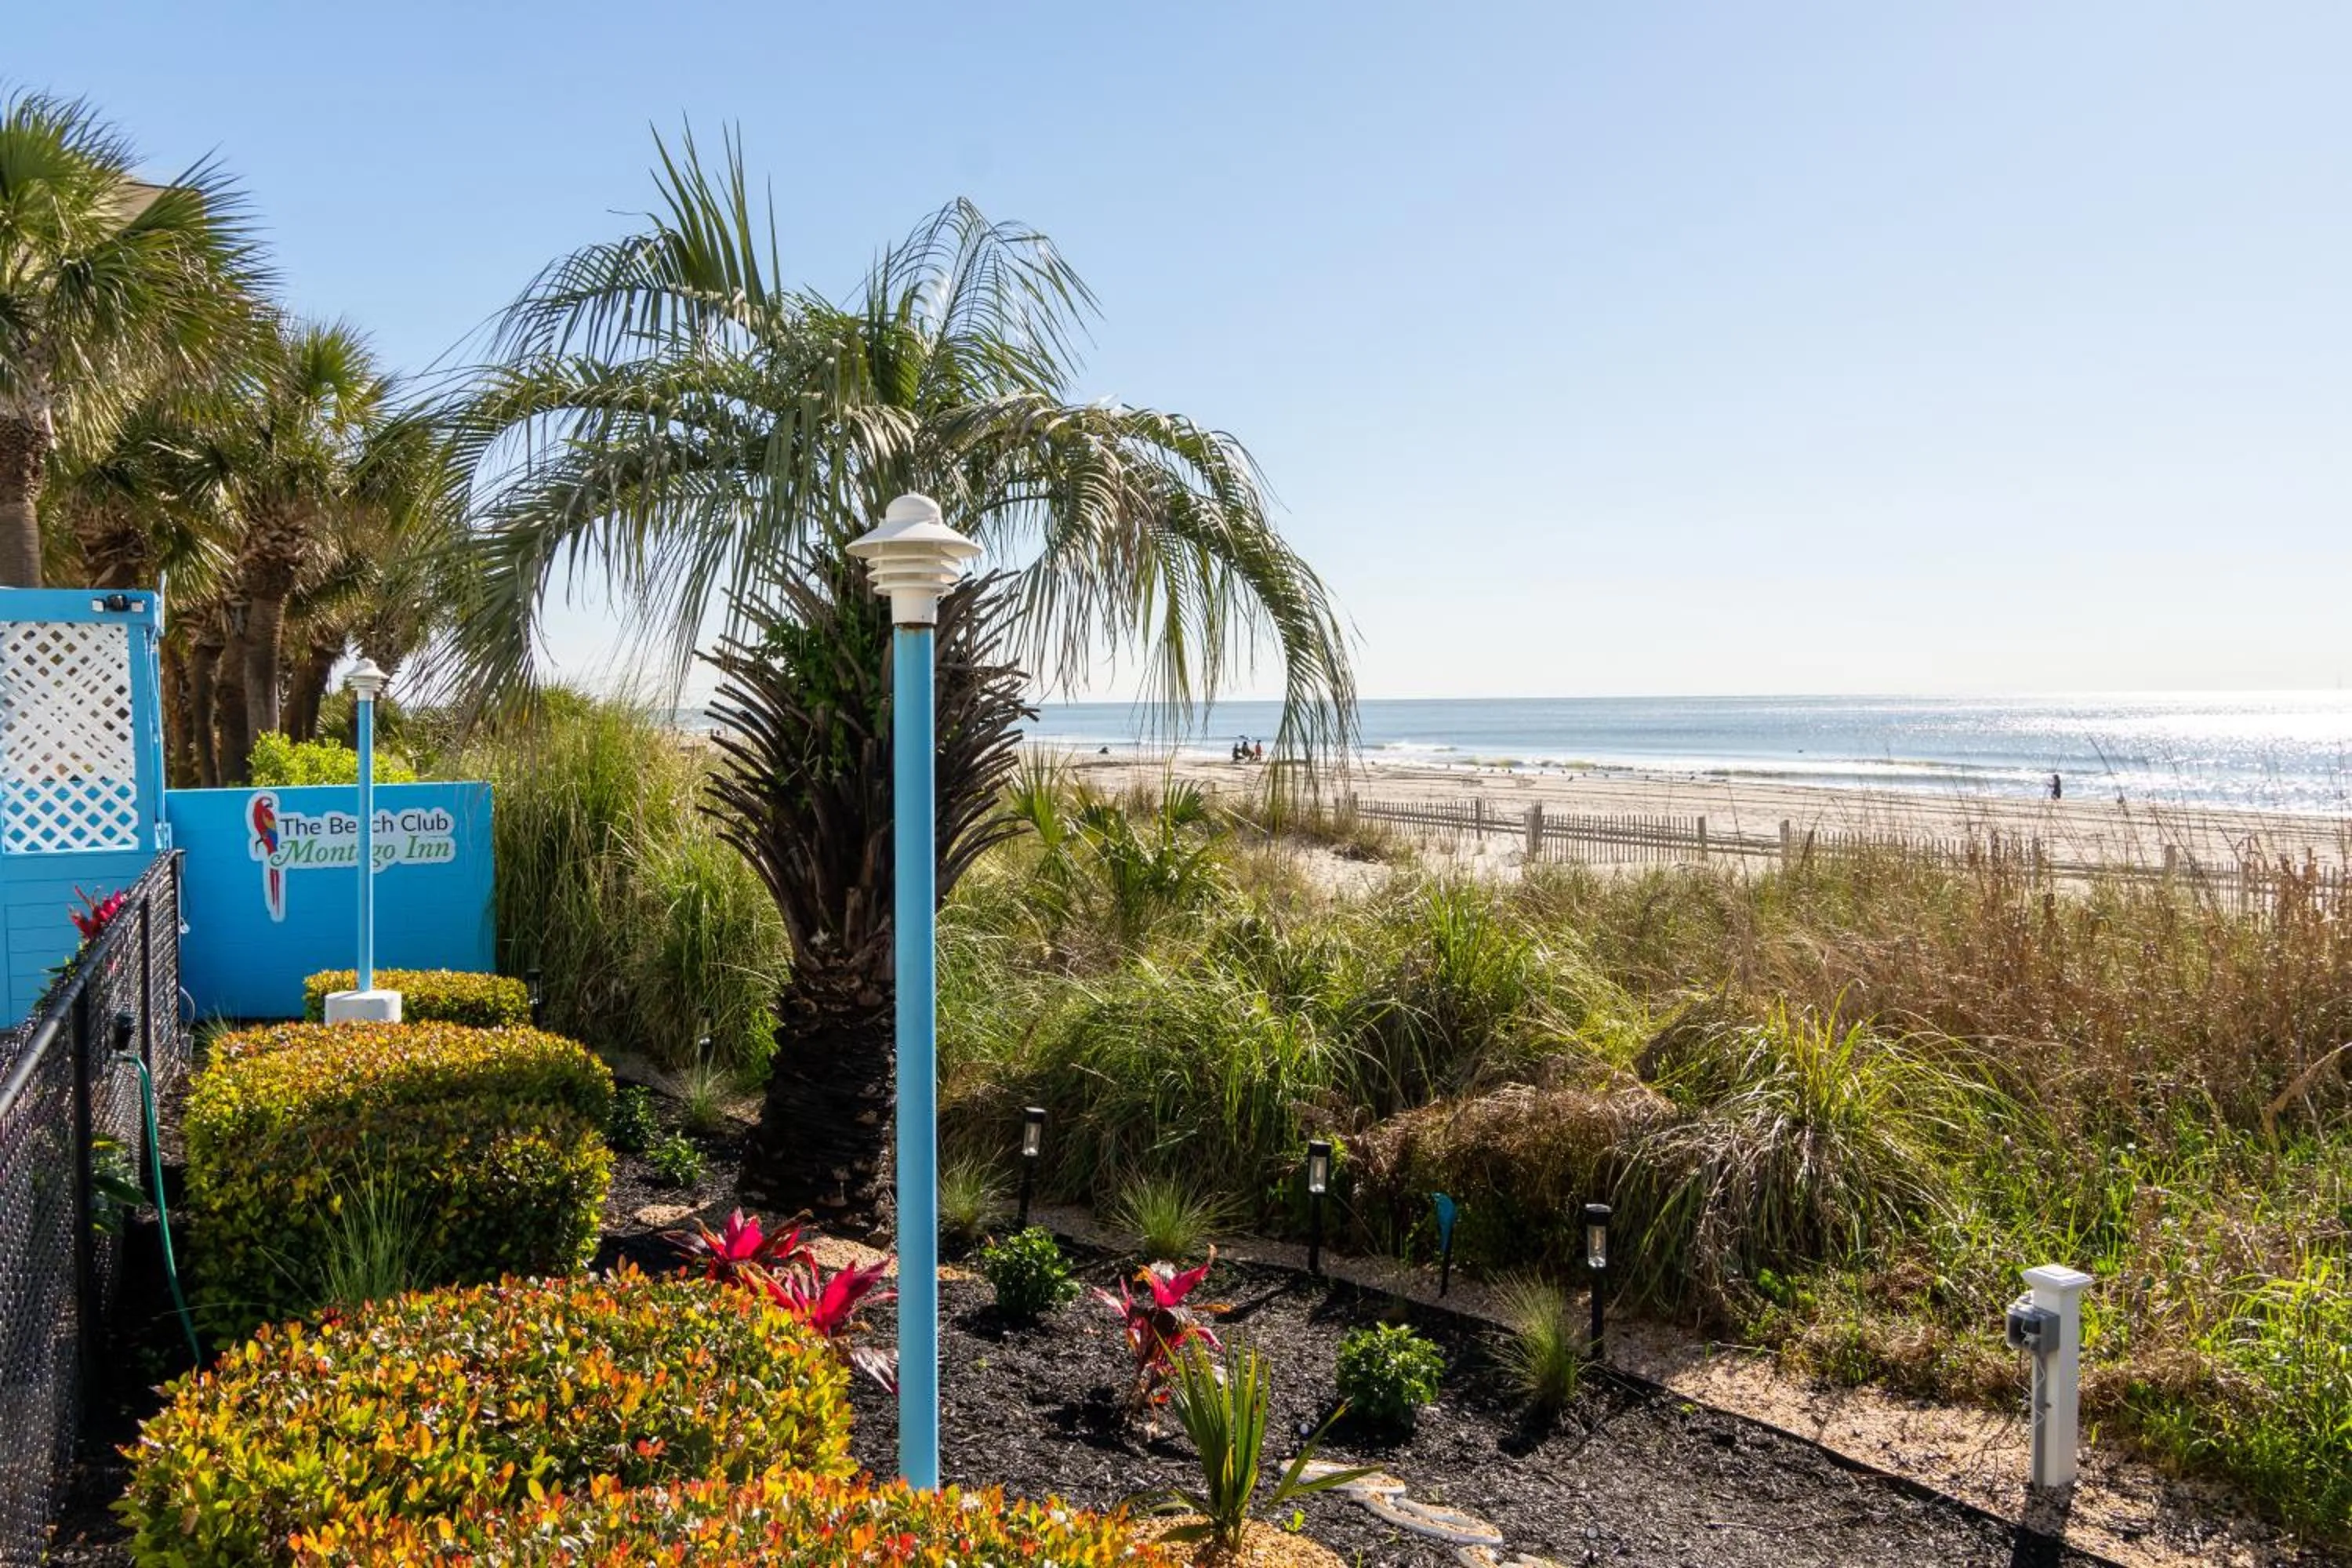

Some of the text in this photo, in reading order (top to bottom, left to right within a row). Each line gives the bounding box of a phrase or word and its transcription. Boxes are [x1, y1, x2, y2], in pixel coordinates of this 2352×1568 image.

[280, 813, 448, 836] The Bech Club
[270, 835, 450, 868] Montgo Inn
